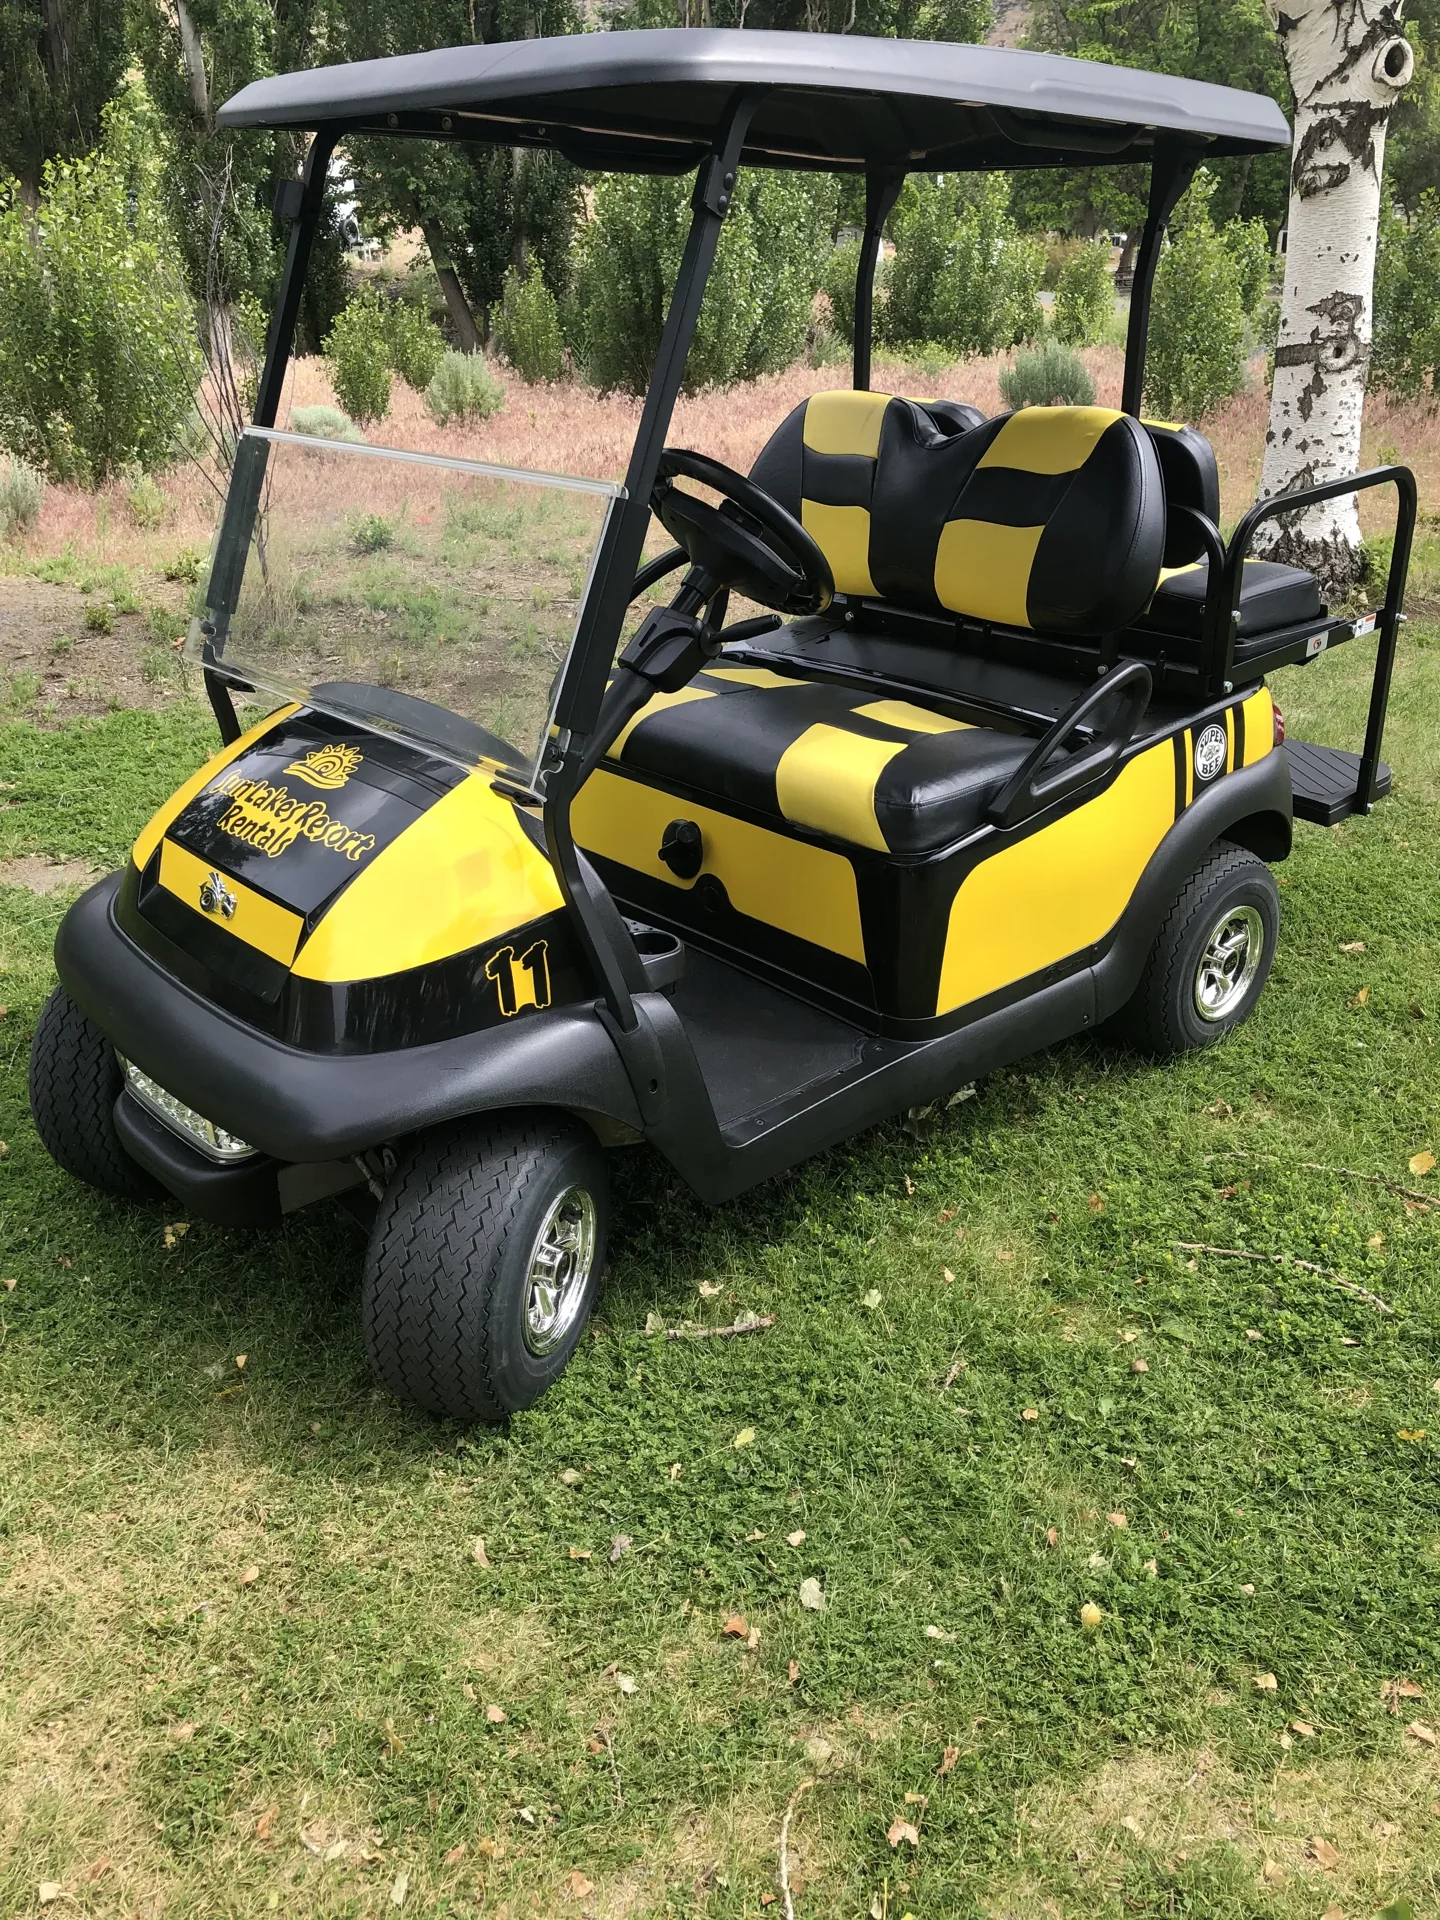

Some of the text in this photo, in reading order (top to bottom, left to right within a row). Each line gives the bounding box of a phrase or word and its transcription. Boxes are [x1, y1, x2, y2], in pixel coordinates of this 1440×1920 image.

[1200, 729, 1224, 759] SUPER
[1202, 756, 1220, 775] BEE
[216, 804, 295, 858] Rentals
[294, 802, 375, 861] Resort
[485, 940, 551, 1016] 11
